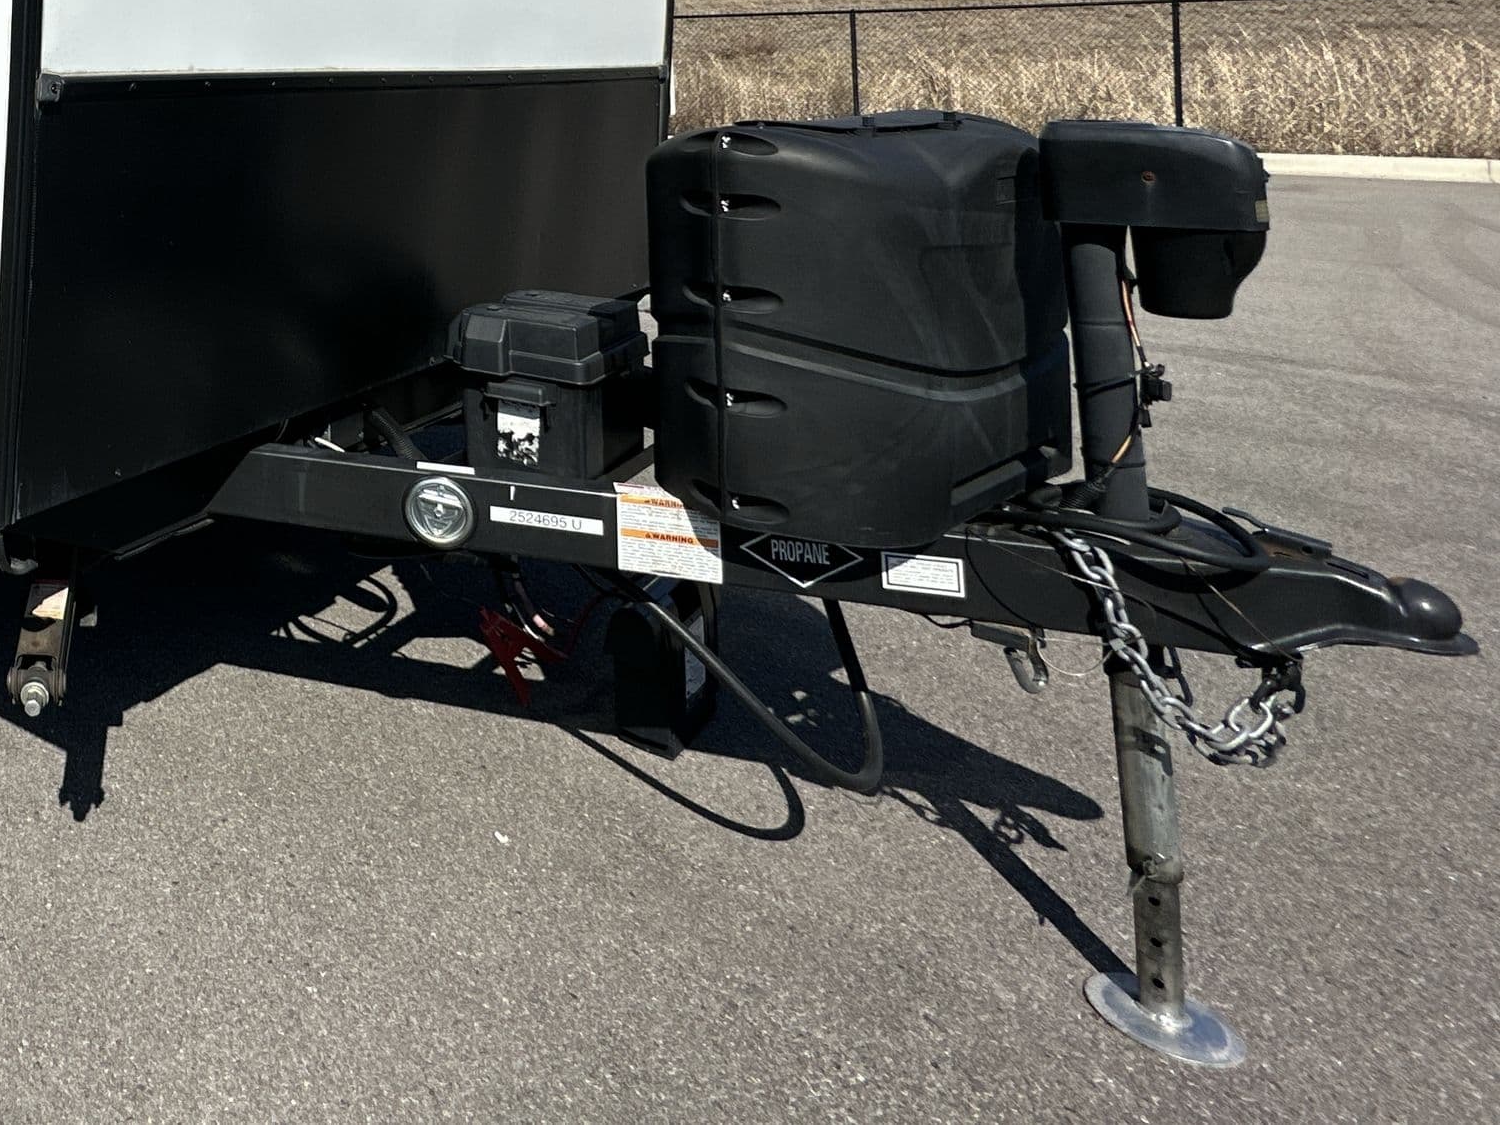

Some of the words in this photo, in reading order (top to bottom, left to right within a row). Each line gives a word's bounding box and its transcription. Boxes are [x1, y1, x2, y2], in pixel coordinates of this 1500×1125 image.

[509, 510, 567, 529] 2524695
[571, 518, 582, 531] U
[652, 532, 694, 544] WARNING
[770, 538, 831, 565] PROPANE
